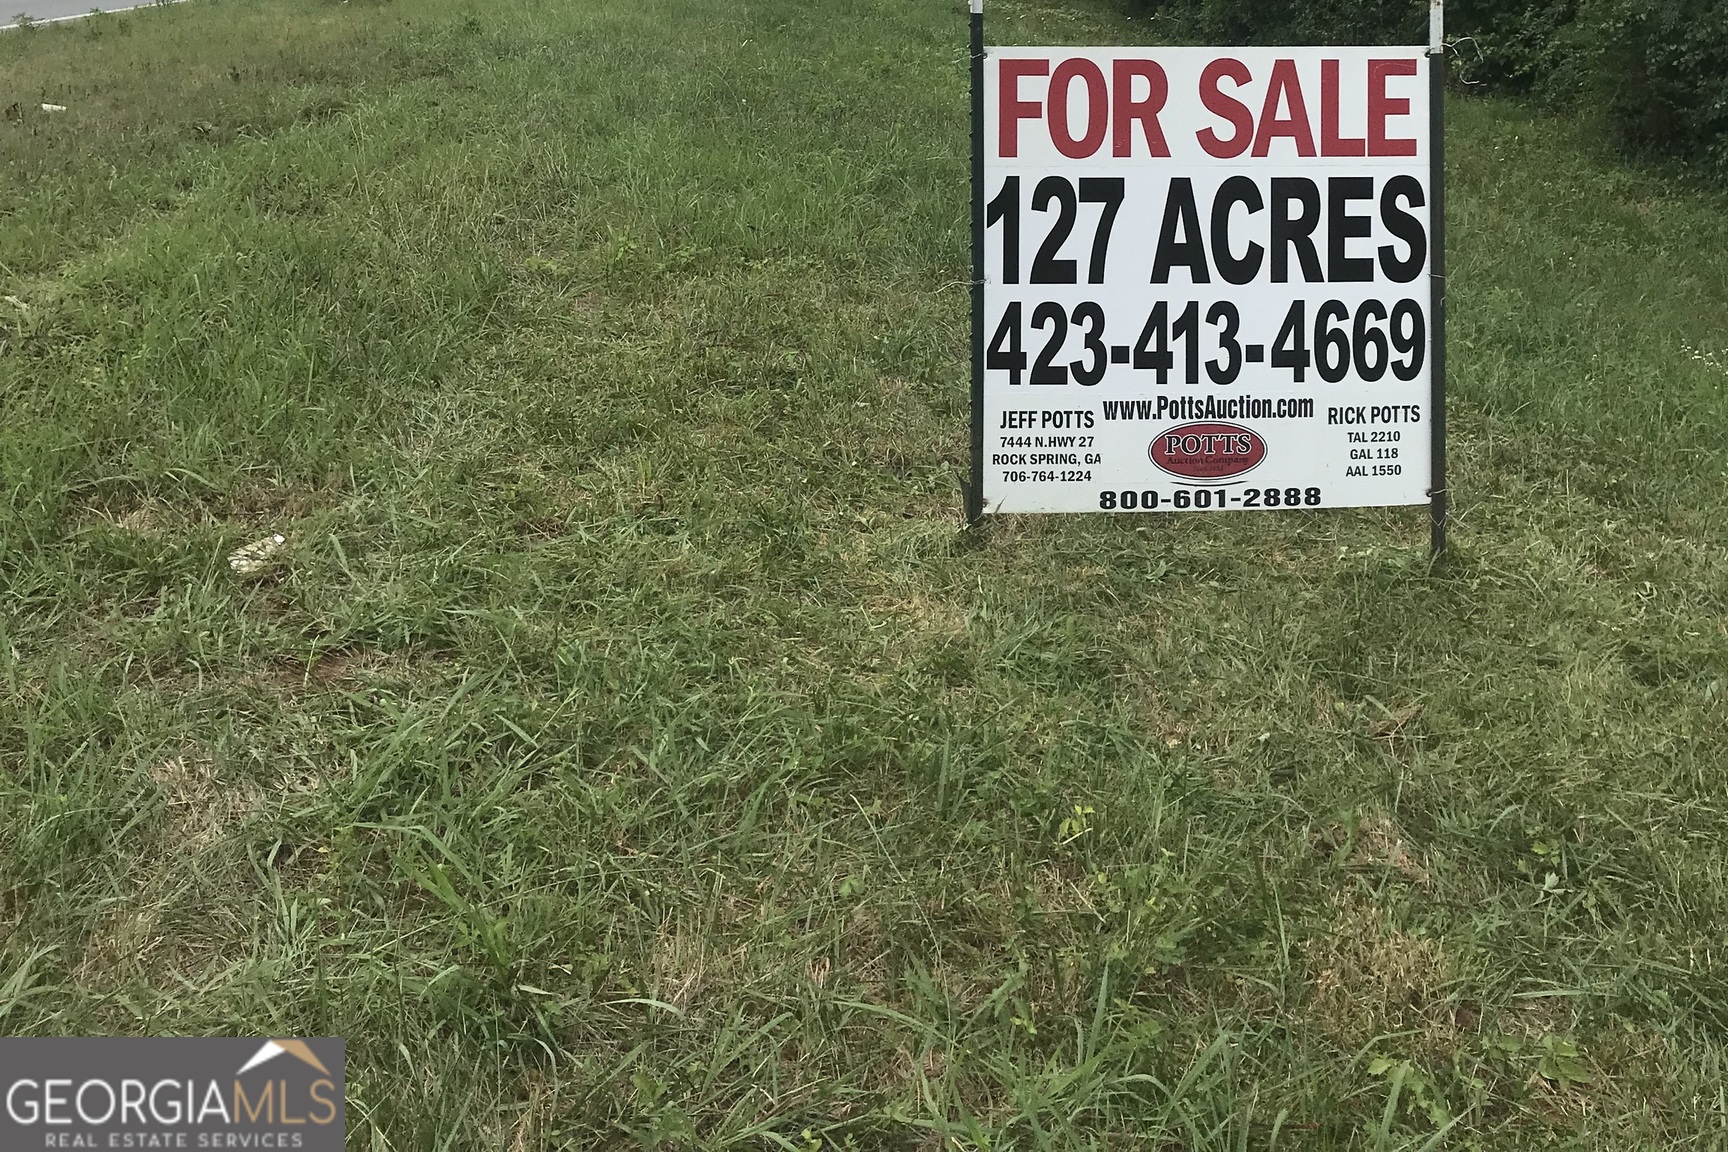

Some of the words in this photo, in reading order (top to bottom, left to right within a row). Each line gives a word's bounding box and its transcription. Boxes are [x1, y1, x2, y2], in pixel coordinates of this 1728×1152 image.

[998, 58, 1171, 159] FOR
[1195, 58, 1418, 159] SALE
[986, 175, 1125, 285] 127
[1150, 174, 1427, 285] ACRES
[986, 298, 1426, 386] 423-413-4669
[1103, 395, 1314, 421] www.PottsAuction.com
[1328, 406, 1366, 425] RICK
[1370, 404, 1420, 424] POTTS
[1000, 410, 1037, 429] JEFF
[1042, 410, 1095, 429] POTTS
[1000, 436, 1032, 448] 7444
[1035, 436, 1076, 448] N.HWY
[1078, 436, 1094, 448] 27
[1164, 433, 1252, 455] POTTS
[1347, 431, 1368, 443] TAL
[1370, 430, 1401, 442] 2210
[992, 453, 1027, 465] ROCK
[1029, 453, 1081, 467] SPRING,
[1084, 453, 1102, 465] GA
[1167, 456, 1203, 465] Auction
[1205, 455, 1248, 466] Company
[1350, 448, 1373, 460] GAL
[1376, 447, 1399, 459] 118
[1002, 470, 1092, 482] 706-764-1224
[1345, 465, 1369, 477] AAL
[1371, 464, 1402, 476] 1550
[1099, 487, 1322, 510] 800-601-2888
